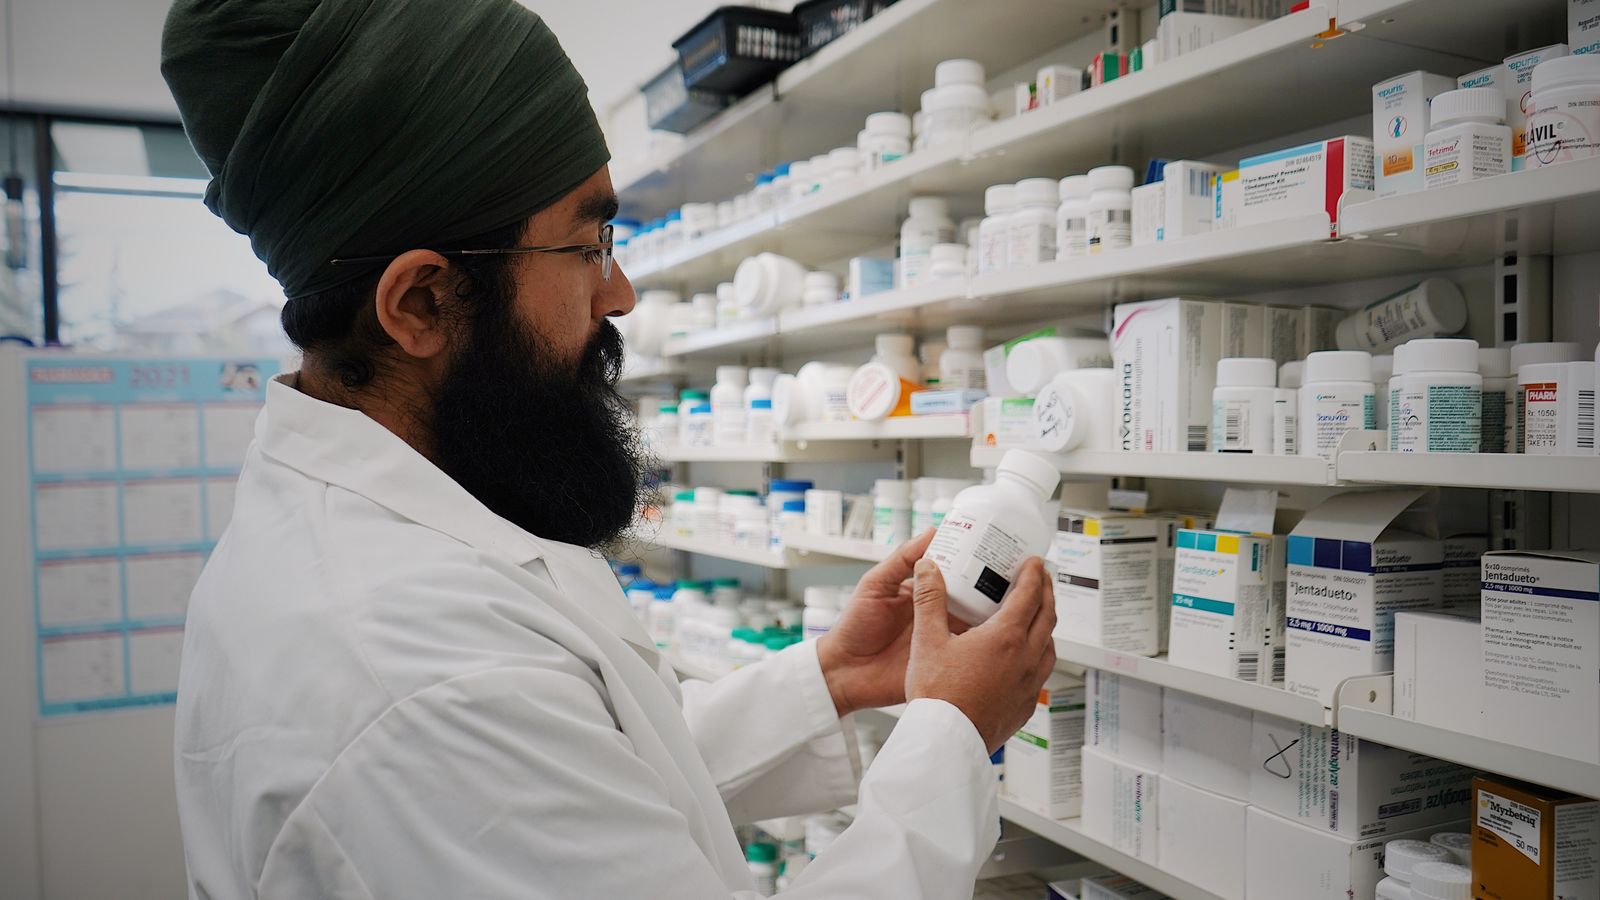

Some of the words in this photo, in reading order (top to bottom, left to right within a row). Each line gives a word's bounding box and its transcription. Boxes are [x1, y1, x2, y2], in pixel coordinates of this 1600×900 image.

[1508, 56, 1539, 70] epuris
[1462, 75, 1491, 88] epuris
[1378, 84, 1404, 98] epuris
[1527, 123, 1556, 146] LAVIL
[1388, 154, 1398, 164] 10
[128, 364, 190, 390] 2021
[1121, 364, 1132, 450] nvokana
[1501, 564, 1530, 573] comprimés
[1490, 802, 1536, 828] Myrbetriq
[1516, 840, 1525, 849] 50
[1527, 845, 1538, 856] mg
